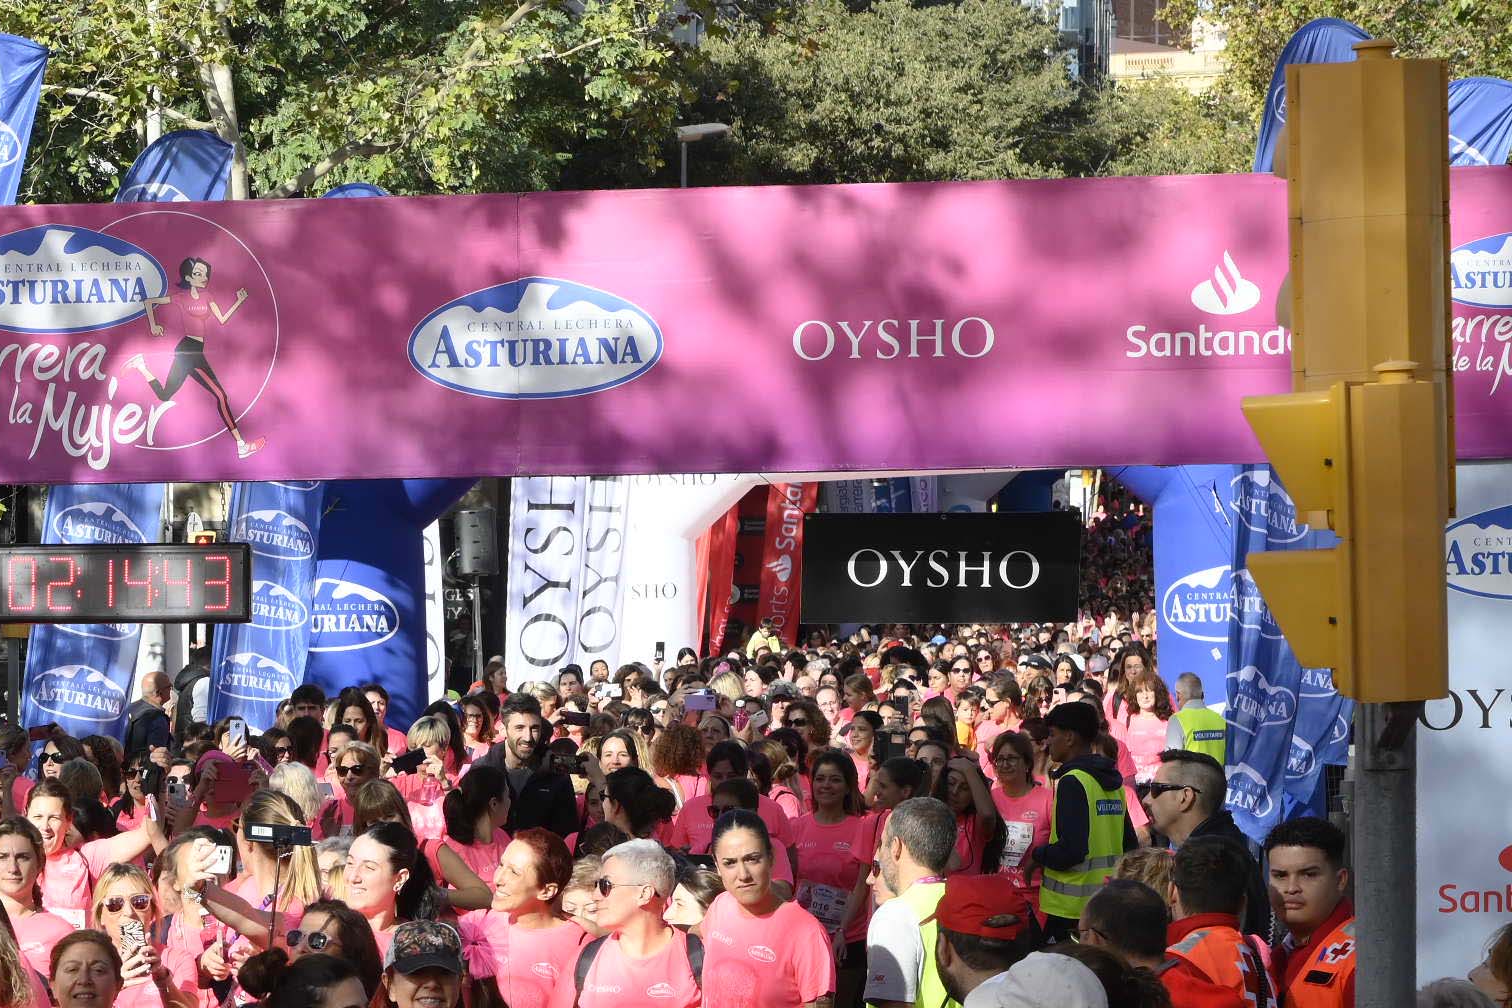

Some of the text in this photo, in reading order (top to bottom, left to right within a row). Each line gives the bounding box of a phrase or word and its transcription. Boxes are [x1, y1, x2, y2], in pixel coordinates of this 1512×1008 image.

[70, 261, 143, 272] LECHERA
[466, 318, 635, 333] CENTRAL LECHERA
[792, 316, 995, 361] OYSHO
[427, 324, 643, 370] ASTURIANA
[1476, 341, 1494, 372] la
[8, 386, 33, 425] la
[28, 376, 177, 471] Mujer
[237, 521, 311, 554] ASTURIANA
[7, 555, 231, 613] 02:14:43
[847, 548, 1041, 590] OYSHO
[336, 604, 386, 612] LECHERA
[37, 679, 121, 715] ASTURIANA
